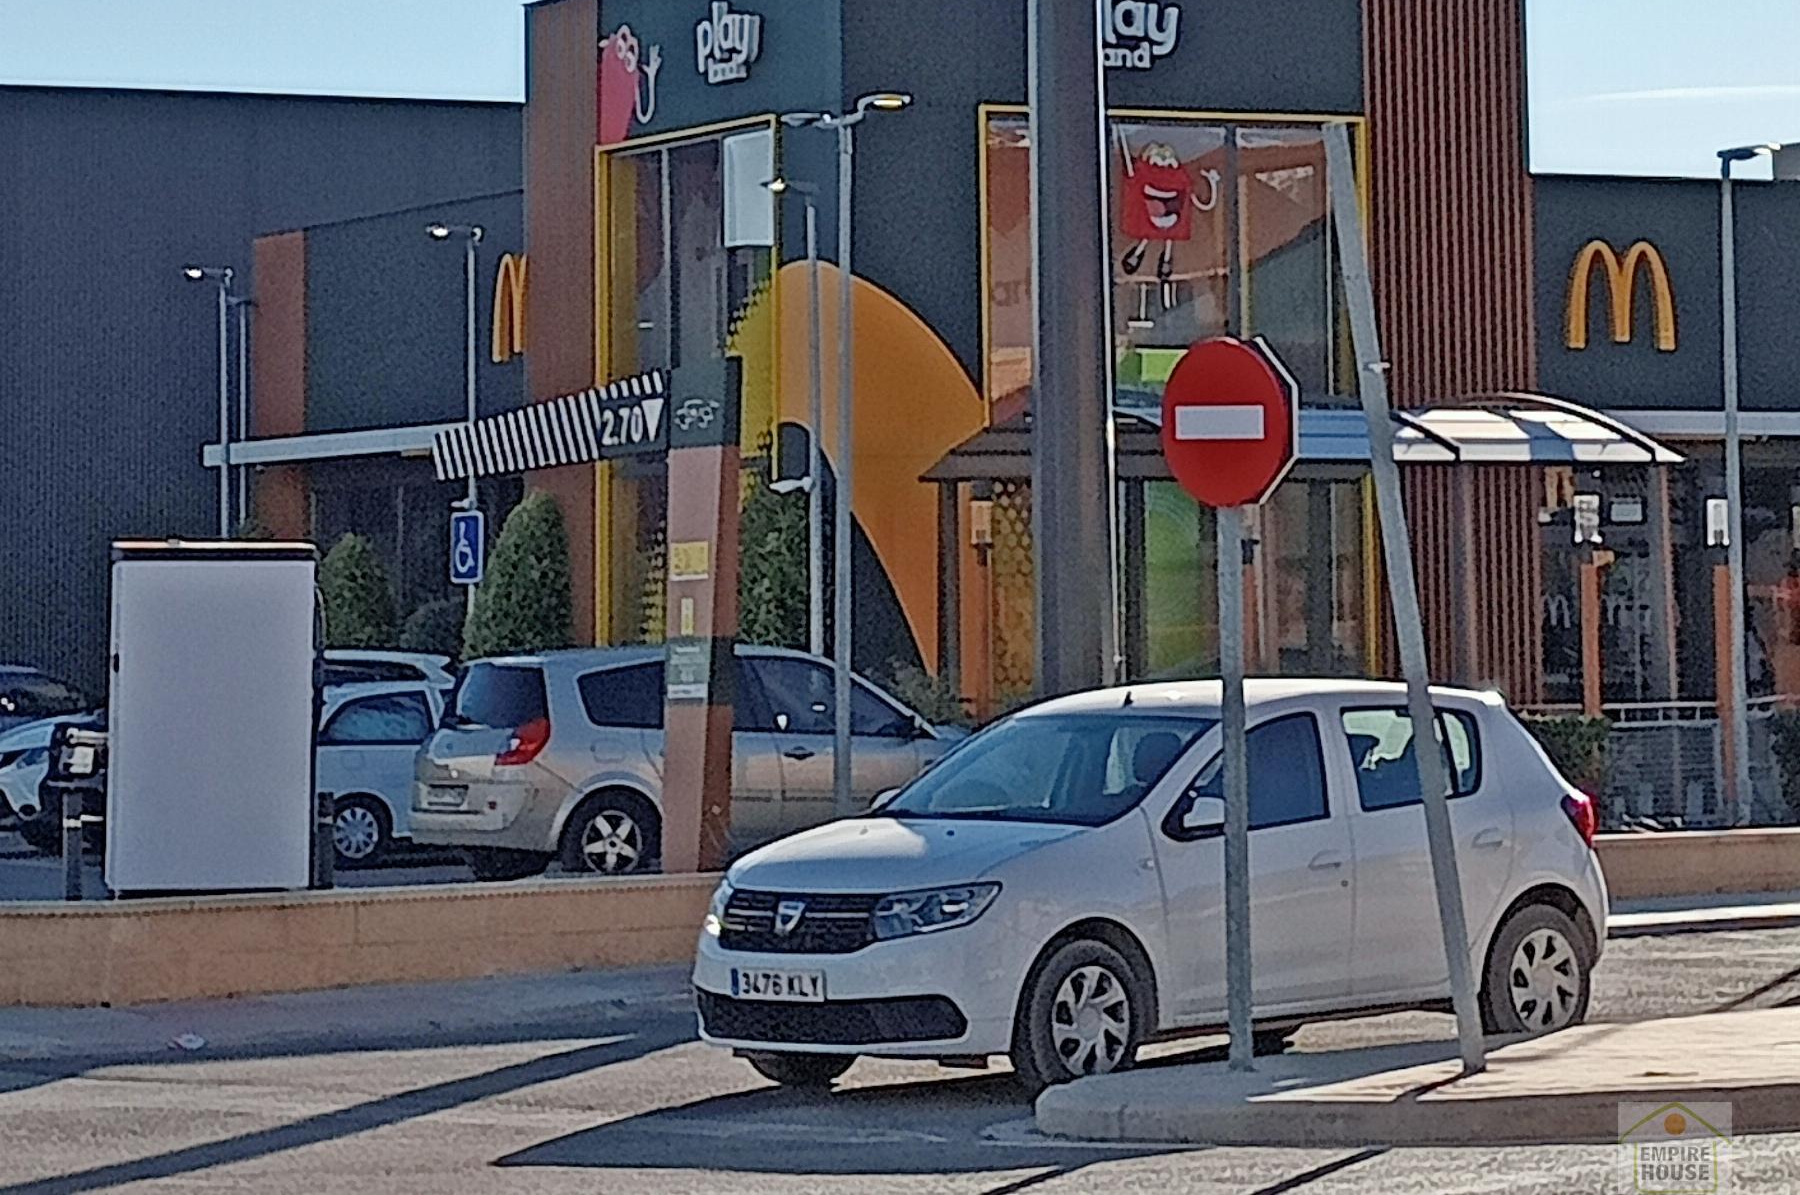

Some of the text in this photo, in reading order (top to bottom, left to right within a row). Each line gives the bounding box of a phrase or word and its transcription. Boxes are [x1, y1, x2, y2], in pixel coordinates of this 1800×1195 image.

[696, 0, 761, 73] play
[1101, 39, 1151, 69] and
[601, 405, 644, 446] 2.70
